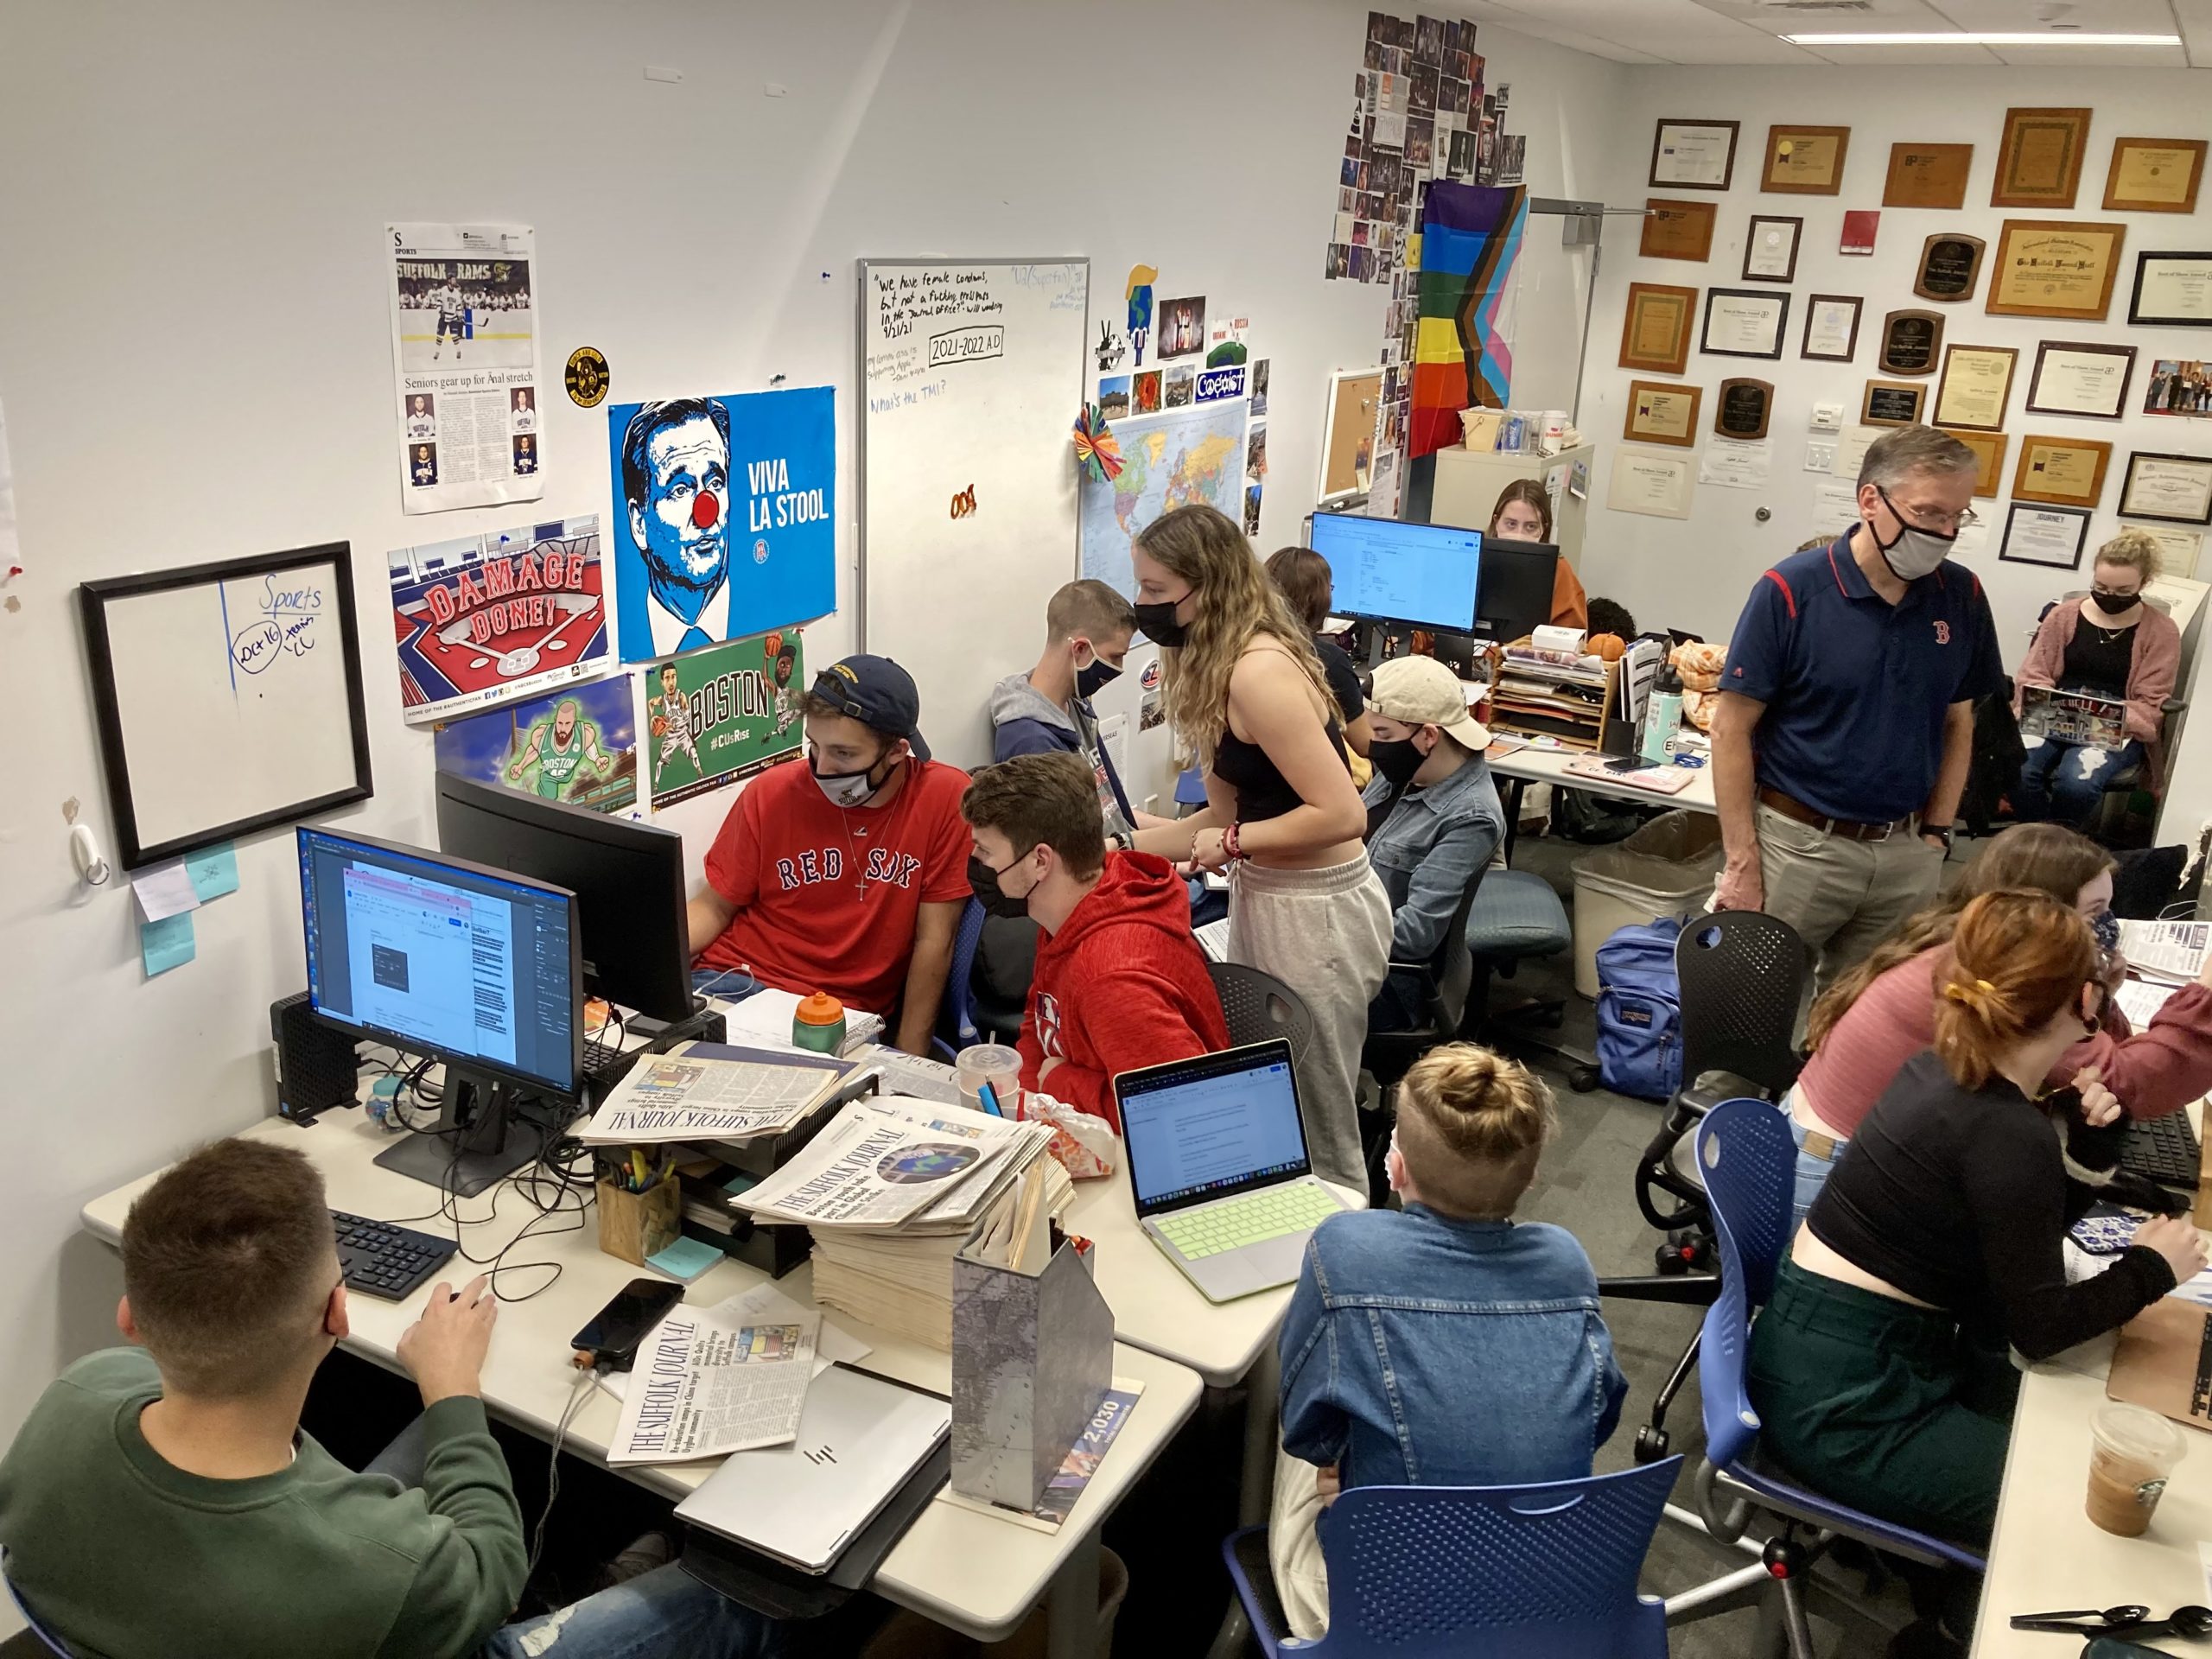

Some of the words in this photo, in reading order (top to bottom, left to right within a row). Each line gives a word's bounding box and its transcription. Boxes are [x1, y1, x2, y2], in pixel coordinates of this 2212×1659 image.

[394, 232, 403, 247] S
[397, 262, 447, 280] SUFFOLK
[457, 263, 492, 280] RAMS
[899, 275, 918, 290] have
[922, 271, 950, 286] female
[880, 291, 897, 311] but
[900, 291, 915, 307] not
[929, 289, 957, 302] fucking
[893, 308, 904, 322] the
[1234, 318, 1249, 329] RUSSIA
[883, 321, 912, 339] 9/21/21
[931, 336, 984, 360] 2021-2022
[405, 377, 439, 389] Seniors
[440, 378, 459, 389] gear
[461, 378, 471, 388] up
[474, 374, 485, 385] for
[506, 372, 533, 385] stretch
[1197, 368, 1244, 399] Coexist
[870, 392, 900, 414] What's
[903, 391, 918, 404] the
[921, 379, 947, 400] TMI?
[747, 459, 790, 496] VIVA
[749, 497, 772, 532] LA
[776, 488, 830, 528] STOOL
[2036, 513, 2065, 524] JOURNEY
[423, 550, 587, 626] DAMAGE
[470, 594, 556, 645] DONE!
[264, 626, 280, 644] 16
[1932, 620, 1950, 645] B
[689, 669, 769, 741] BOSTON
[544, 757, 578, 770] BOSTON
[777, 848, 843, 891] RED
[865, 848, 921, 889] SOX
[607, 1109, 682, 1131] JOURNAL
[683, 1112, 754, 1129] SUFFOLK
[773, 1193, 811, 1211] THE
[797, 1163, 861, 1202] SUFFOLK
[842, 1128, 906, 1168] JOURNAL
[805, 1199, 836, 1217] Boston
[834, 1185, 855, 1203] youth
[854, 1175, 872, 1187] take
[822, 1206, 840, 1219] part
[843, 1187, 871, 1203] Global
[652, 1320, 695, 1377] JOURNAL
[694, 1339, 706, 1355] Quilts
[706, 1330, 719, 1345] brings
[703, 1345, 714, 1367] memorial
[711, 1347, 722, 1367] diversity
[721, 1349, 731, 1367] Suffolk
[728, 1332, 737, 1350] campus
[690, 1370, 701, 1387] target
[637, 1380, 681, 1429] SUFFOLK
[683, 1386, 696, 1402] China
[681, 1407, 690, 1422] camps
[1083, 1402, 1120, 1444] 2,030
[669, 1422, 685, 1453] Re-education
[681, 1434, 696, 1453] Uyghur
[690, 1409, 704, 1434] community
[629, 1432, 667, 1454] THE
